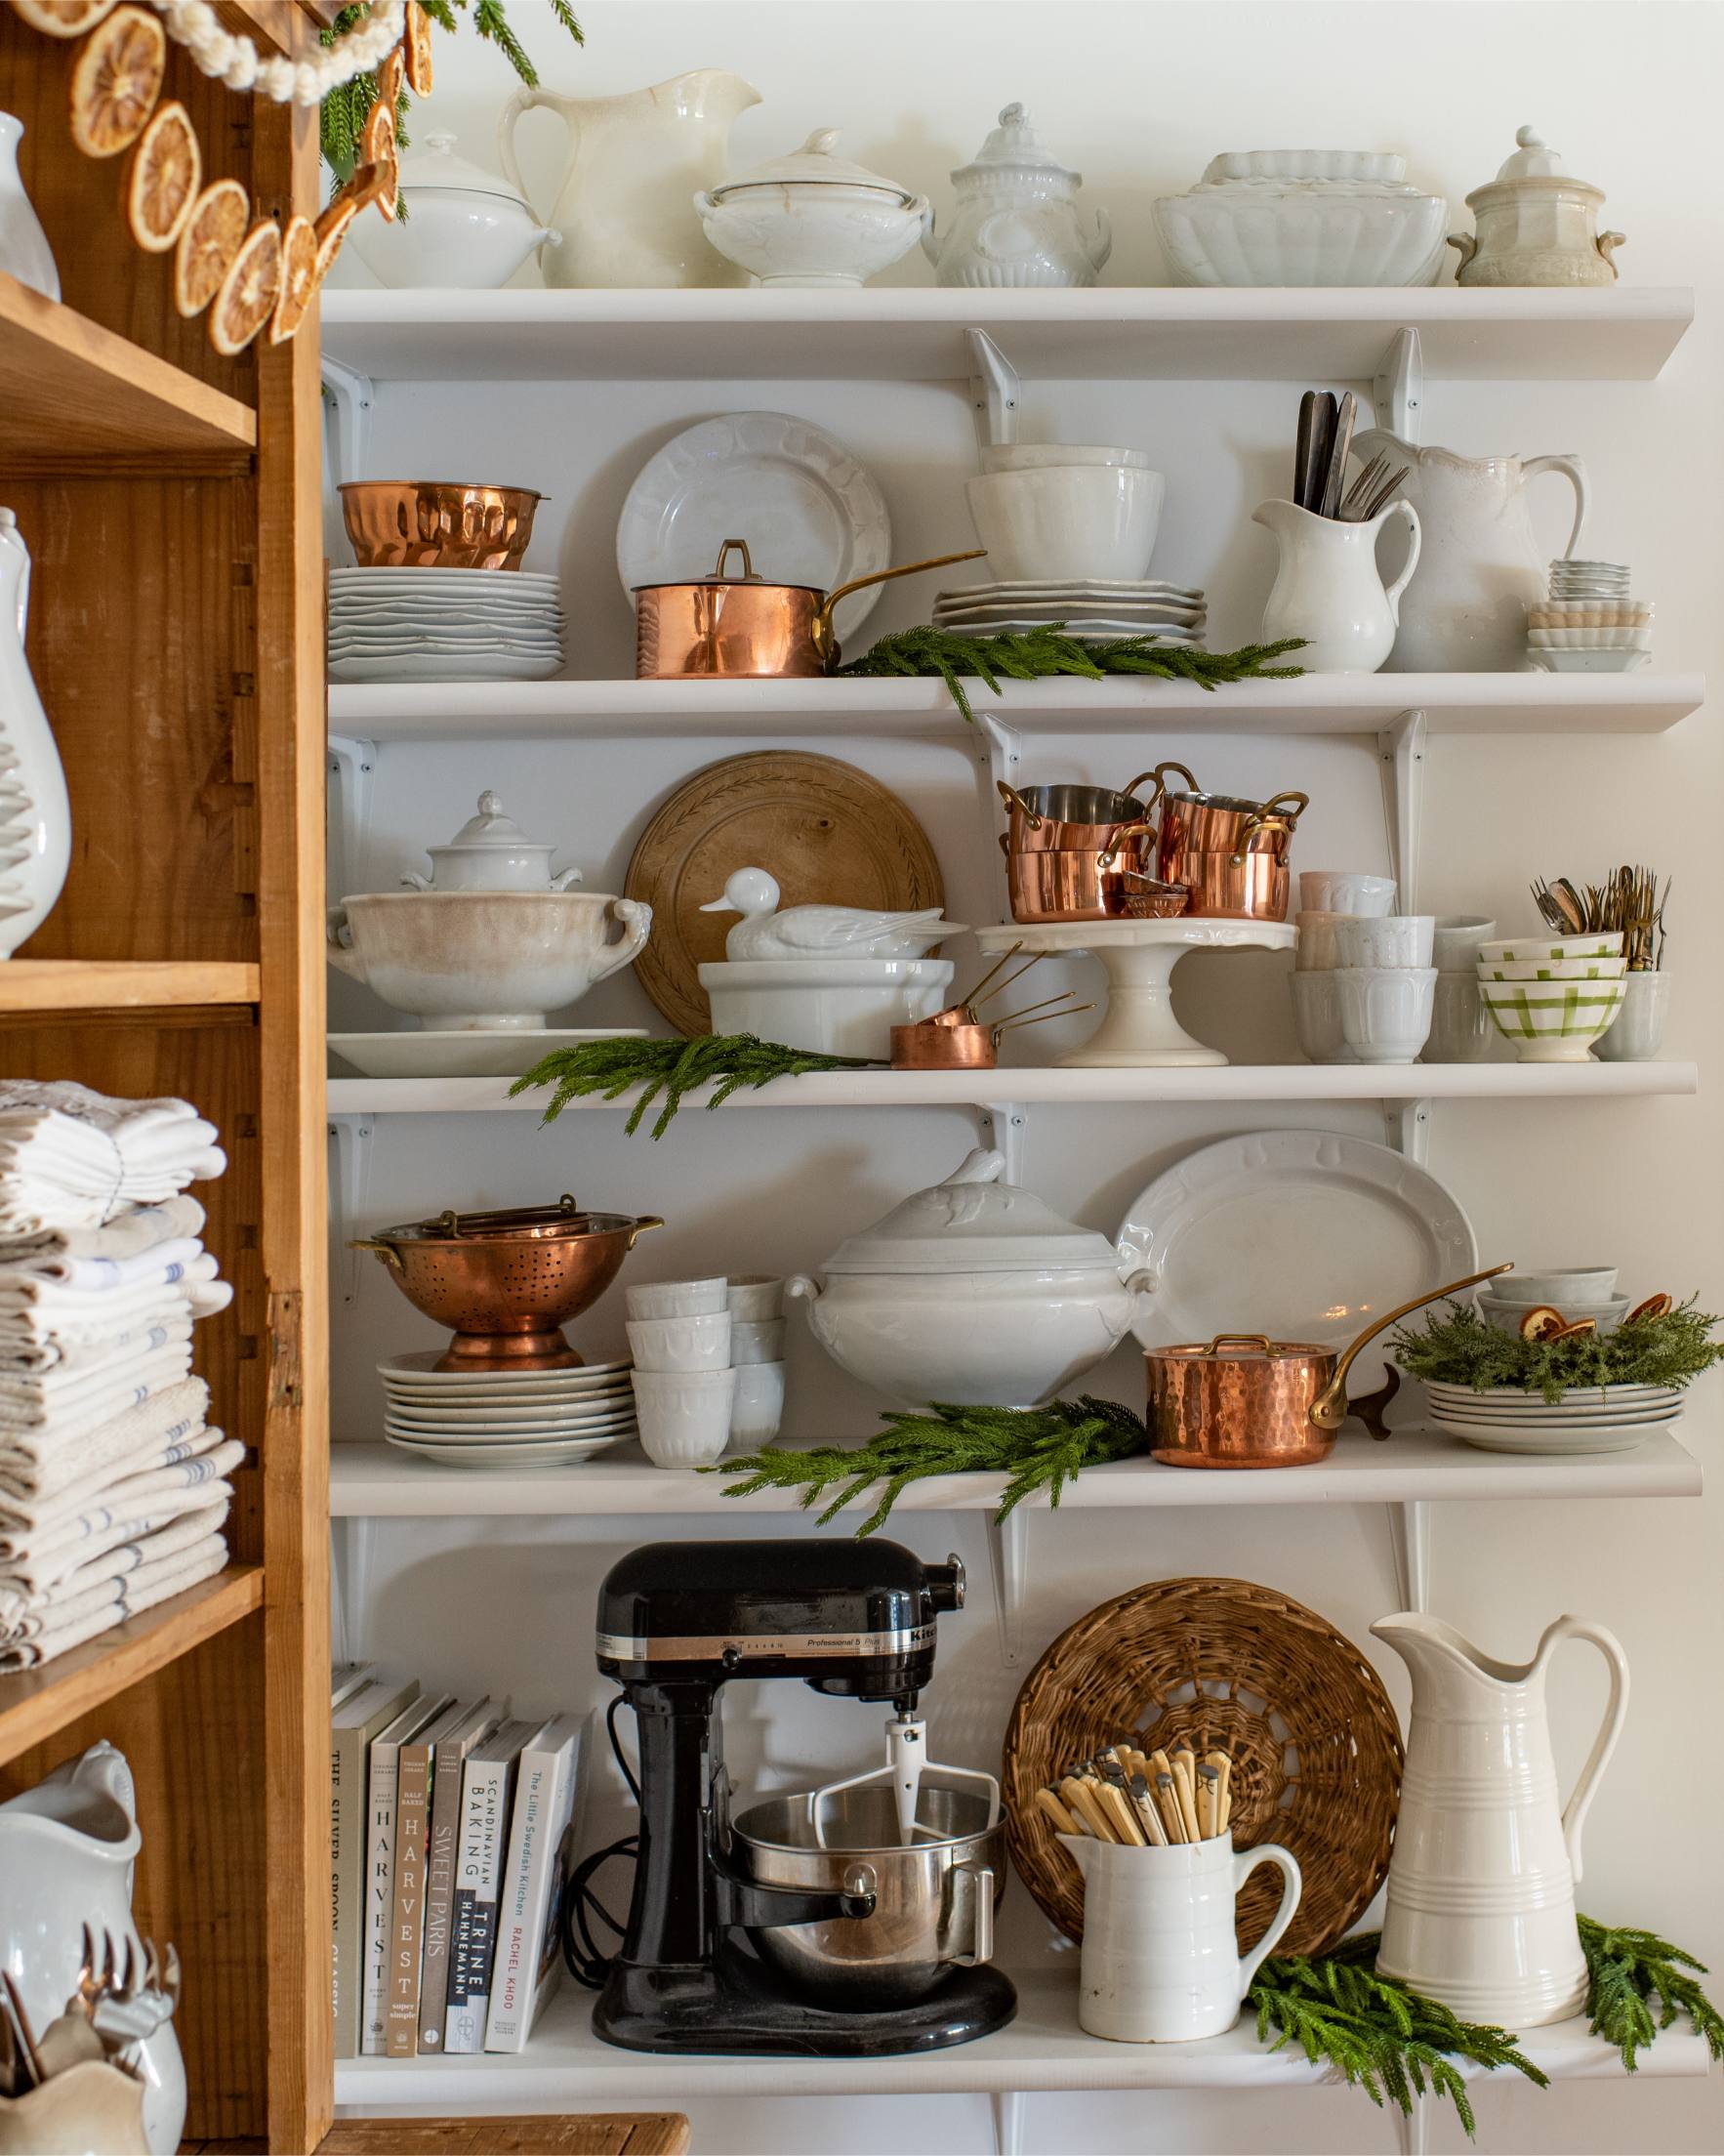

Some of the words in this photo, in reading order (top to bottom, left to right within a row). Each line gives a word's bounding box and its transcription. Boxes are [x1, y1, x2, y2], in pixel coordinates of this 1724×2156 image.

[526, 1795, 539, 1823] Little
[530, 1771, 543, 1791] The
[465, 1787, 484, 1876] BAKING
[481, 1779, 497, 1885] SCANDINAVIAN
[520, 1826, 536, 1872] Swedish
[431, 1826, 452, 1895] SWEET
[373, 1811, 389, 1979] HARVEST
[398, 1819, 419, 1993] HARVEST
[514, 1875, 529, 1917] Kitchen
[428, 1902, 447, 1958] PARIS
[455, 1901, 472, 1995] HAHNEMANN
[469, 1912, 488, 1986] TRINE
[508, 1927, 522, 1972] RACHEL
[390, 2011, 417, 2020] simple
[503, 1977, 516, 2010] KHOO
